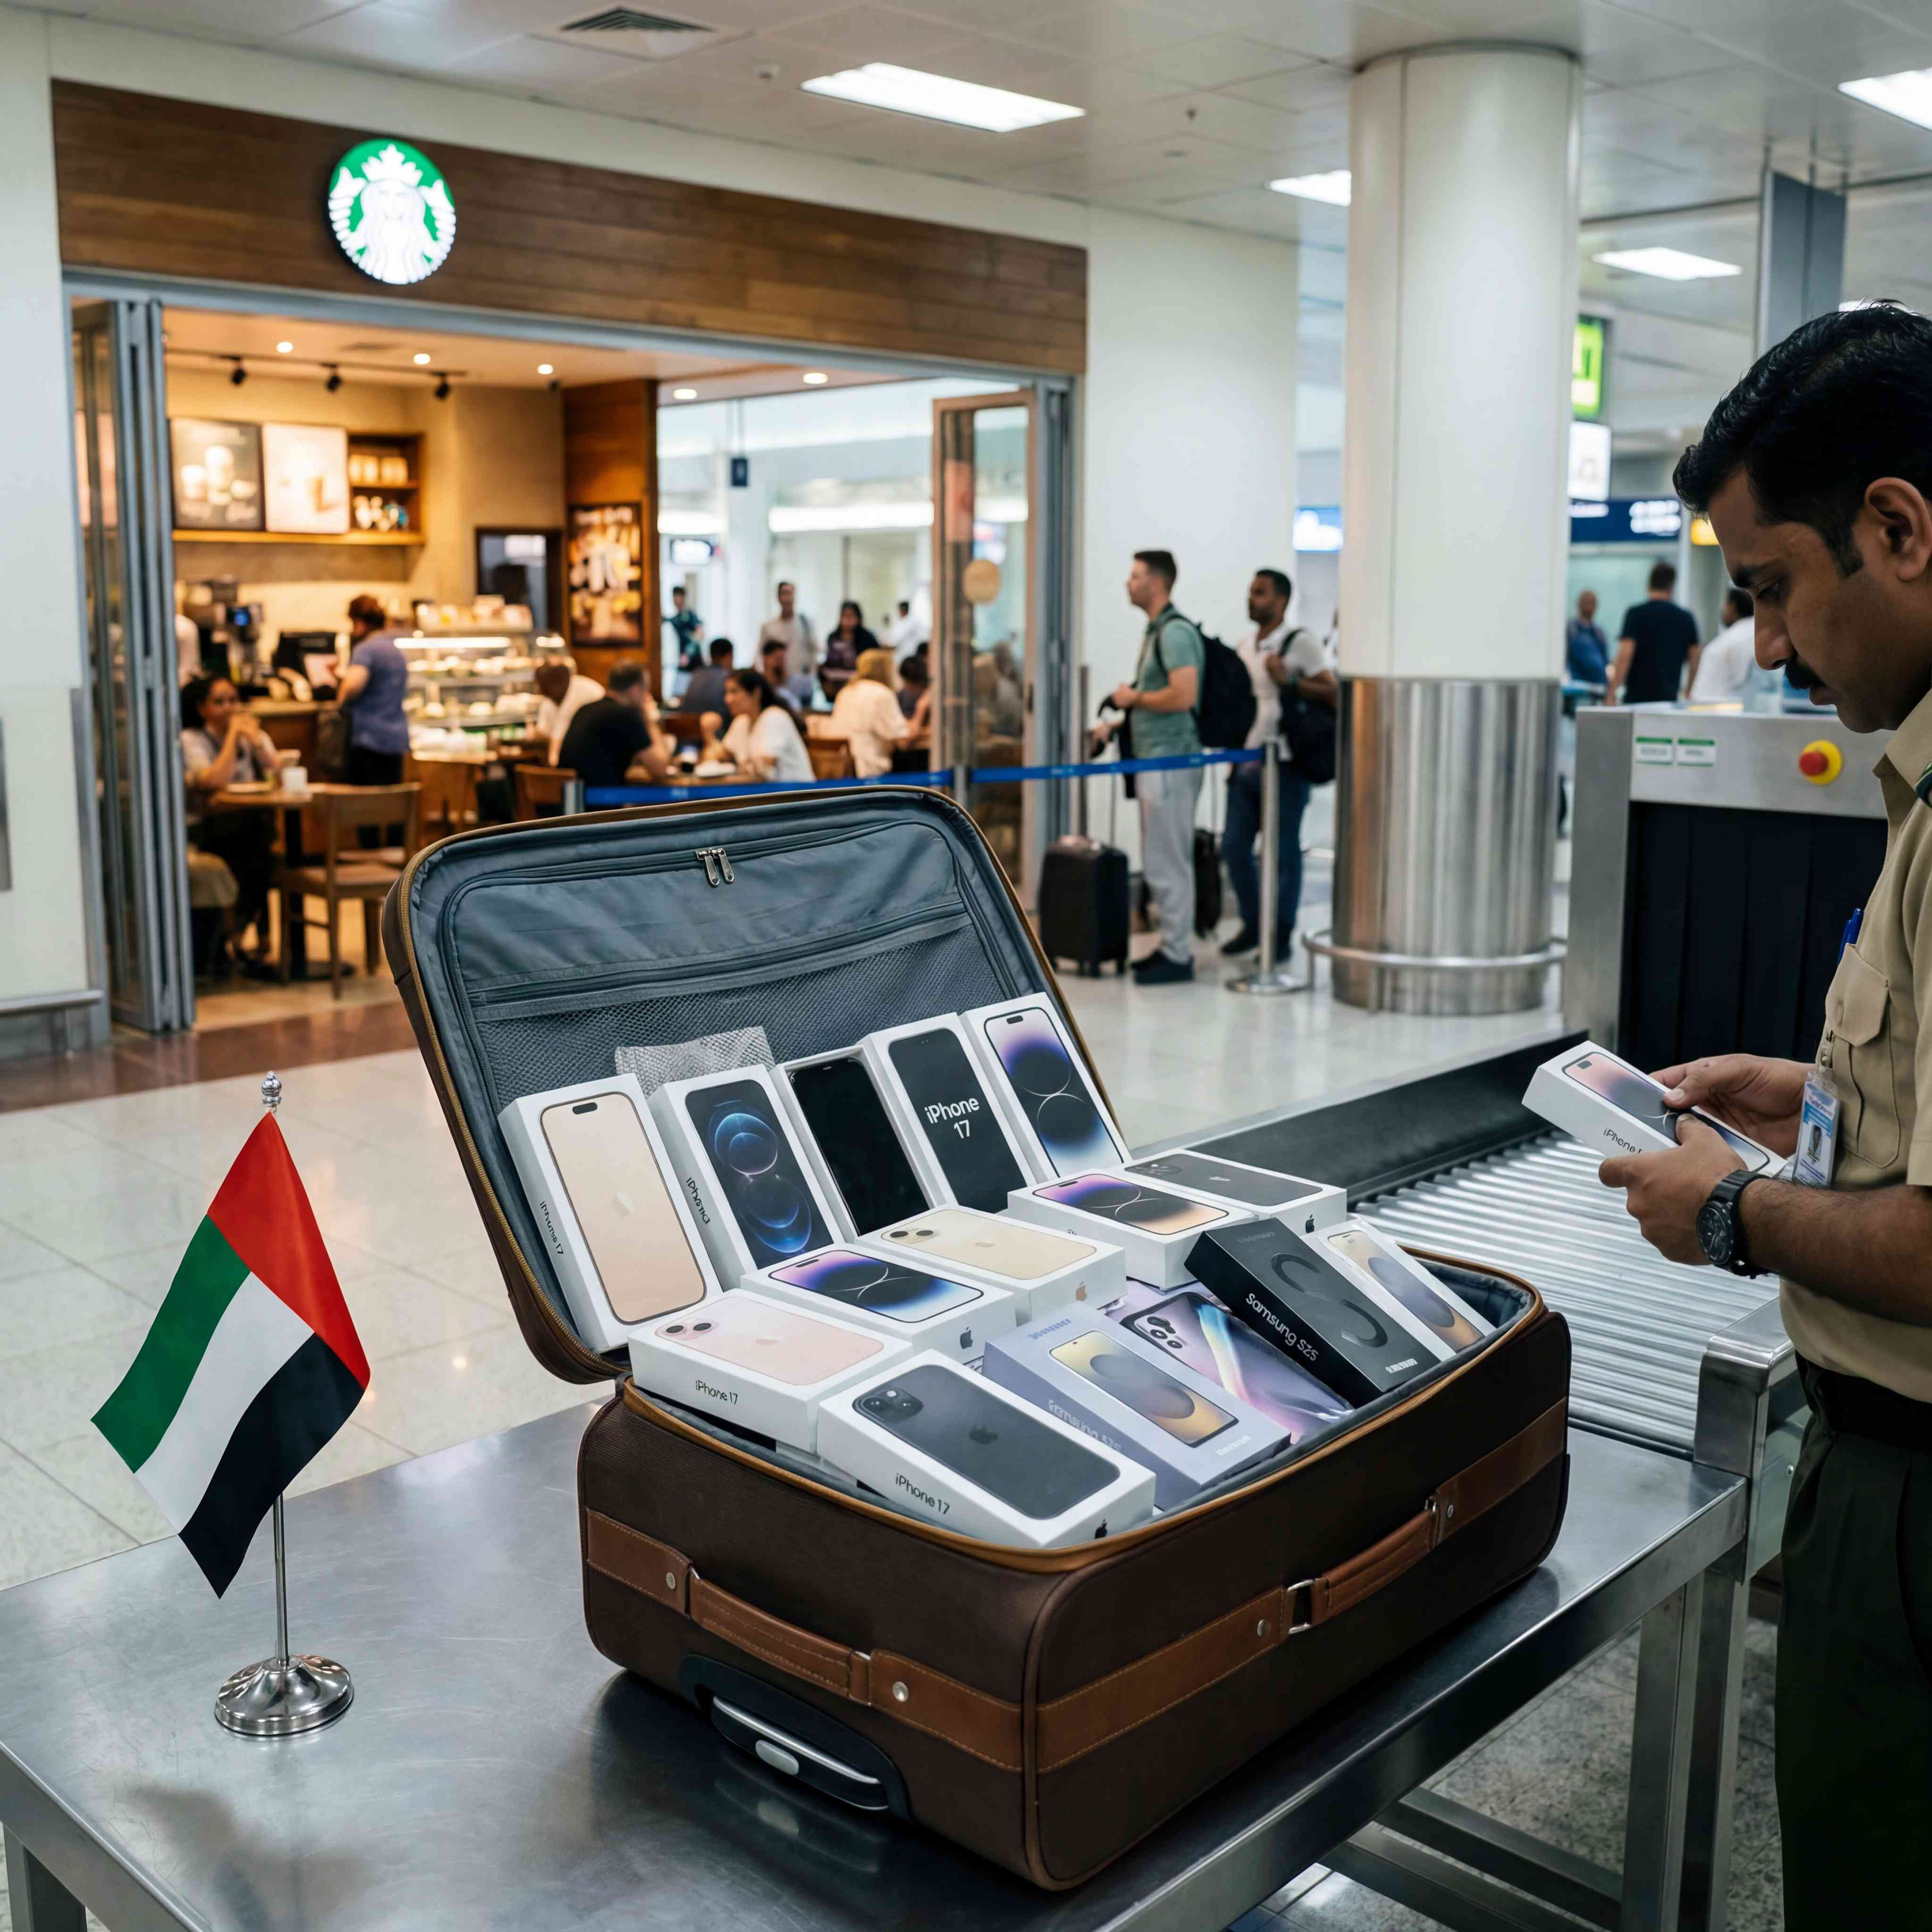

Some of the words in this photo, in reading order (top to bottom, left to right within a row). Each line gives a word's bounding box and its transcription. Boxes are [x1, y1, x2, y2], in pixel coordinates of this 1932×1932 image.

[924, 1098, 980, 1124] iPhone
[954, 1119, 970, 1139] 17
[1603, 1127, 1635, 1153] iPhone
[1246, 1293, 1297, 1346] Samsung
[1297, 1339, 1319, 1361] S25
[695, 1380, 727, 1401] iPhone
[729, 1391, 738, 1405] 17
[896, 1473, 935, 1507] iPhone
[938, 1499, 950, 1515] 17
